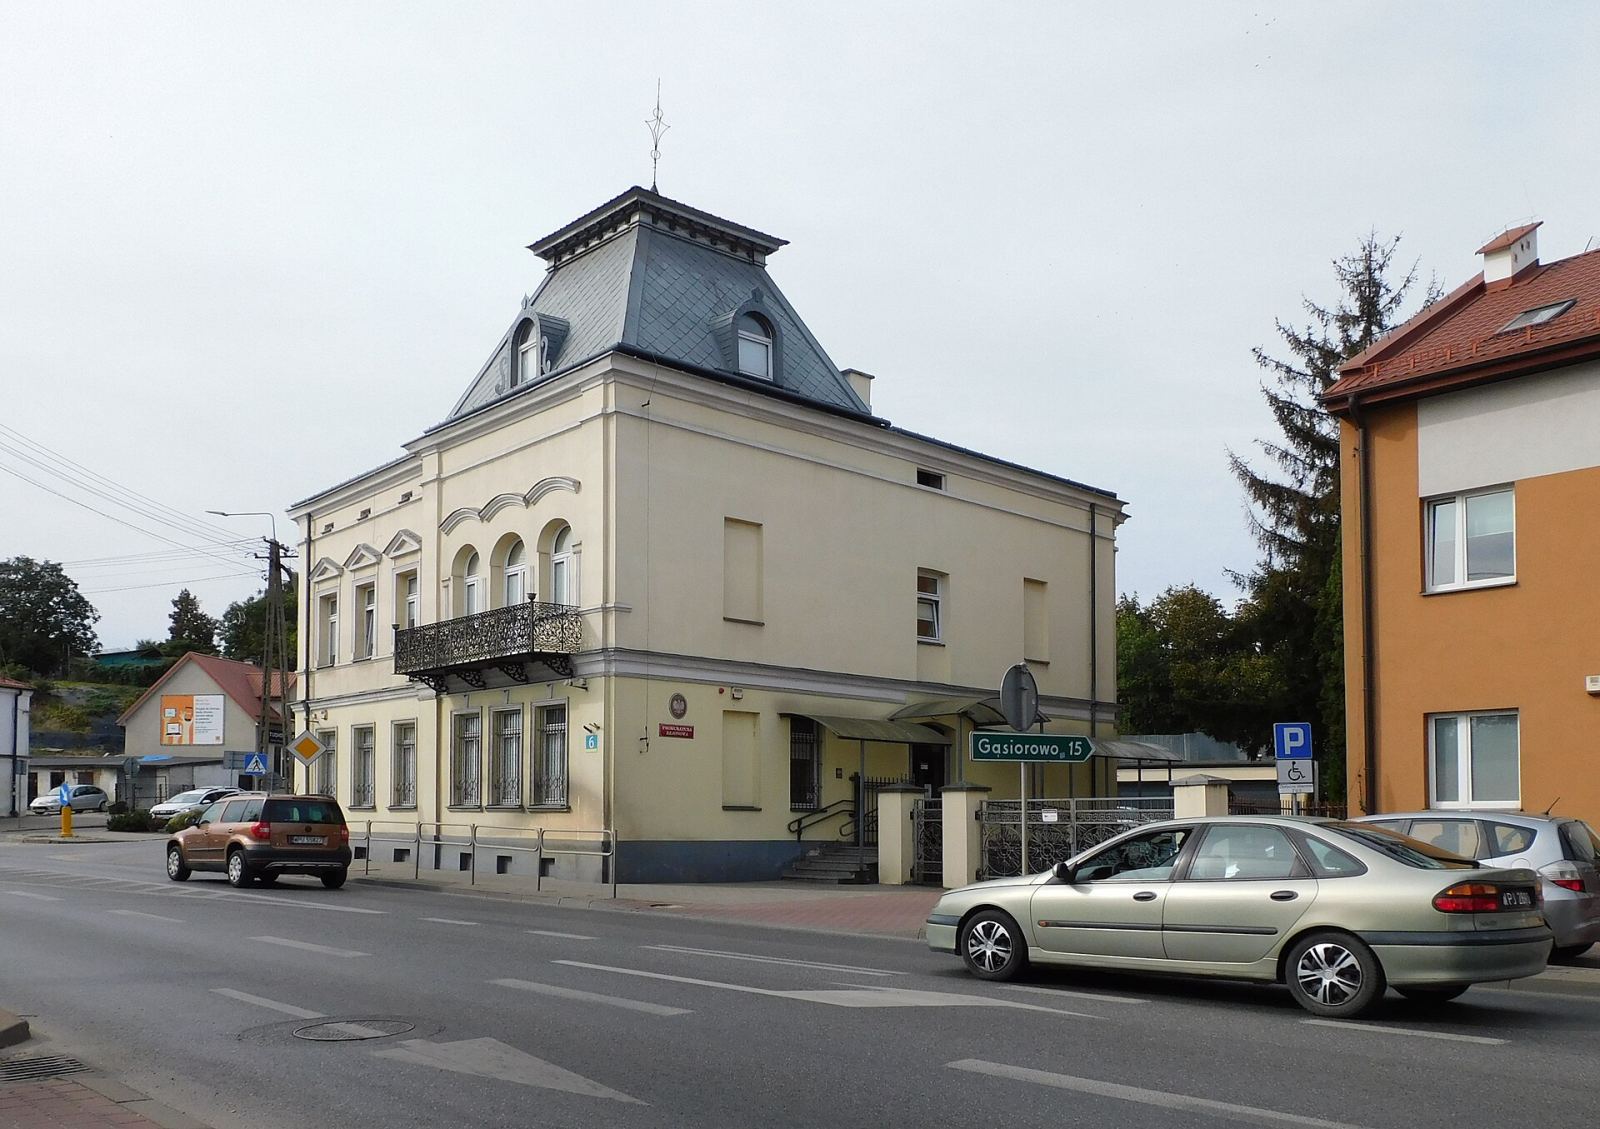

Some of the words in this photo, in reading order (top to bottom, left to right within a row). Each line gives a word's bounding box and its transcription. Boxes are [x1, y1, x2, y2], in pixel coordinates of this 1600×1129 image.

[588, 735, 595, 748] 6
[978, 738, 1059, 758] Gąsiorowo
[1068, 741, 1083, 756] 15
[1283, 727, 1304, 755] P
